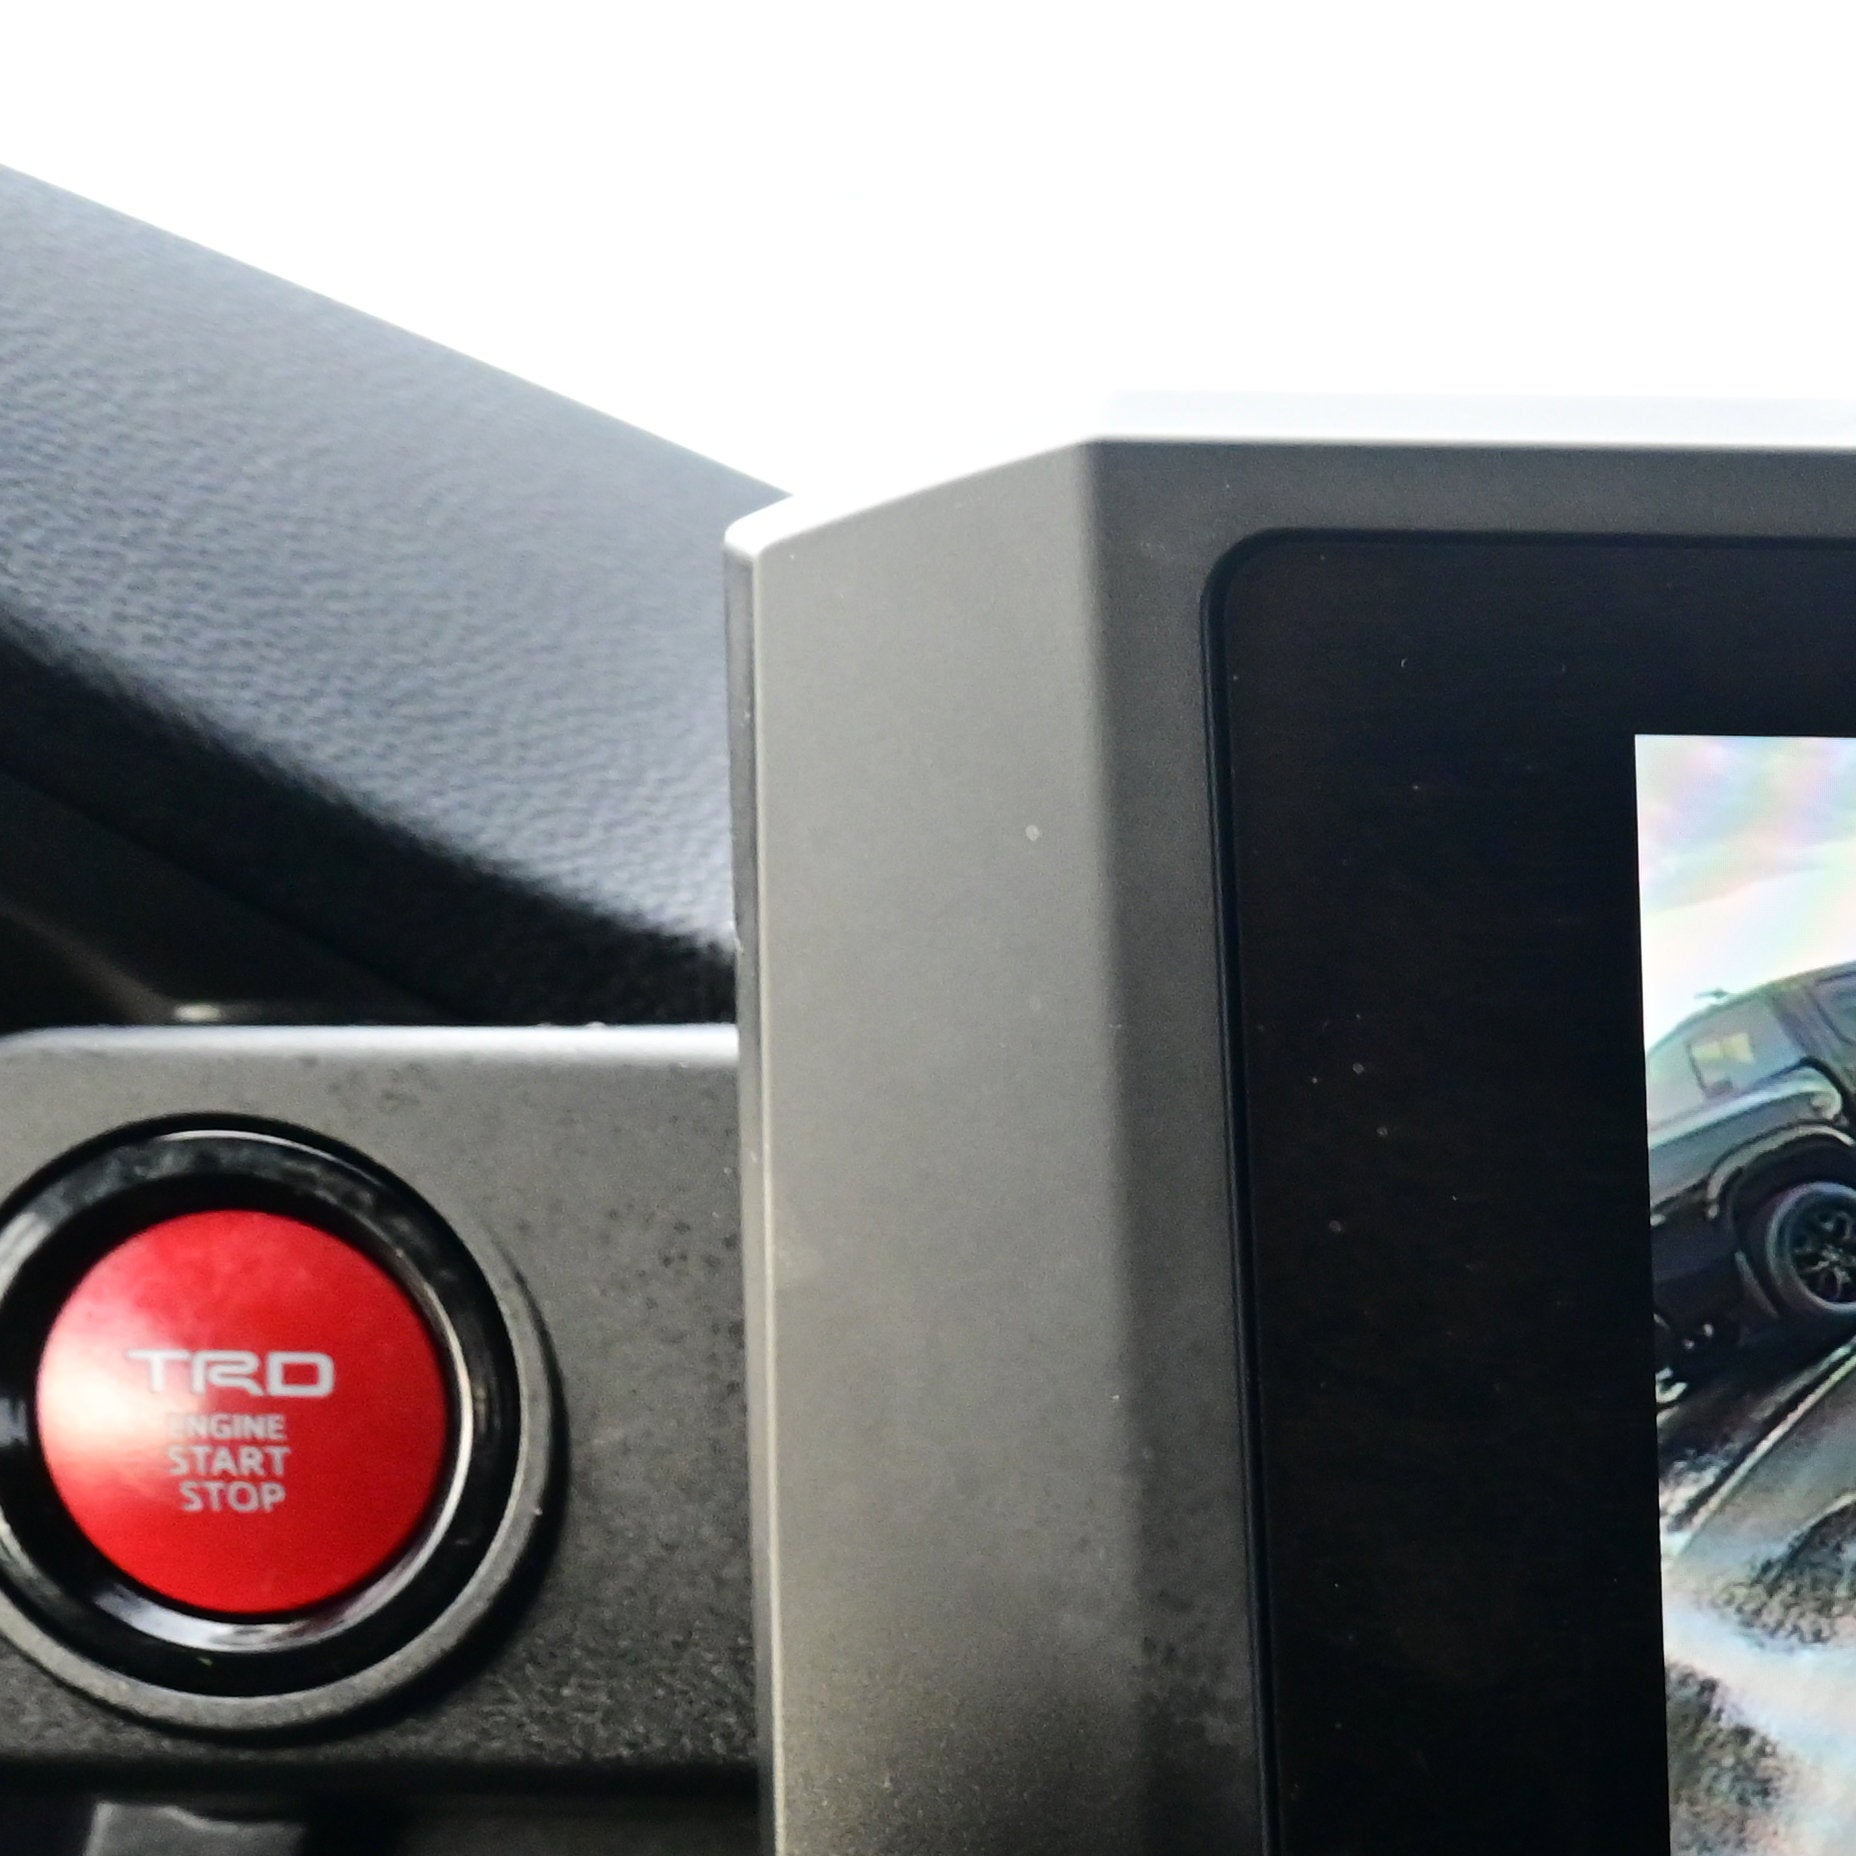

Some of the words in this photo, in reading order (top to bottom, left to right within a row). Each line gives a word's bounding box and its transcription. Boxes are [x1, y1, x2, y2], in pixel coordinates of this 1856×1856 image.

[126, 1349, 334, 1398] TRD
[168, 1413, 286, 1440] ENGINE
[168, 1445, 290, 1476] START
[180, 1480, 286, 1513] STOP
